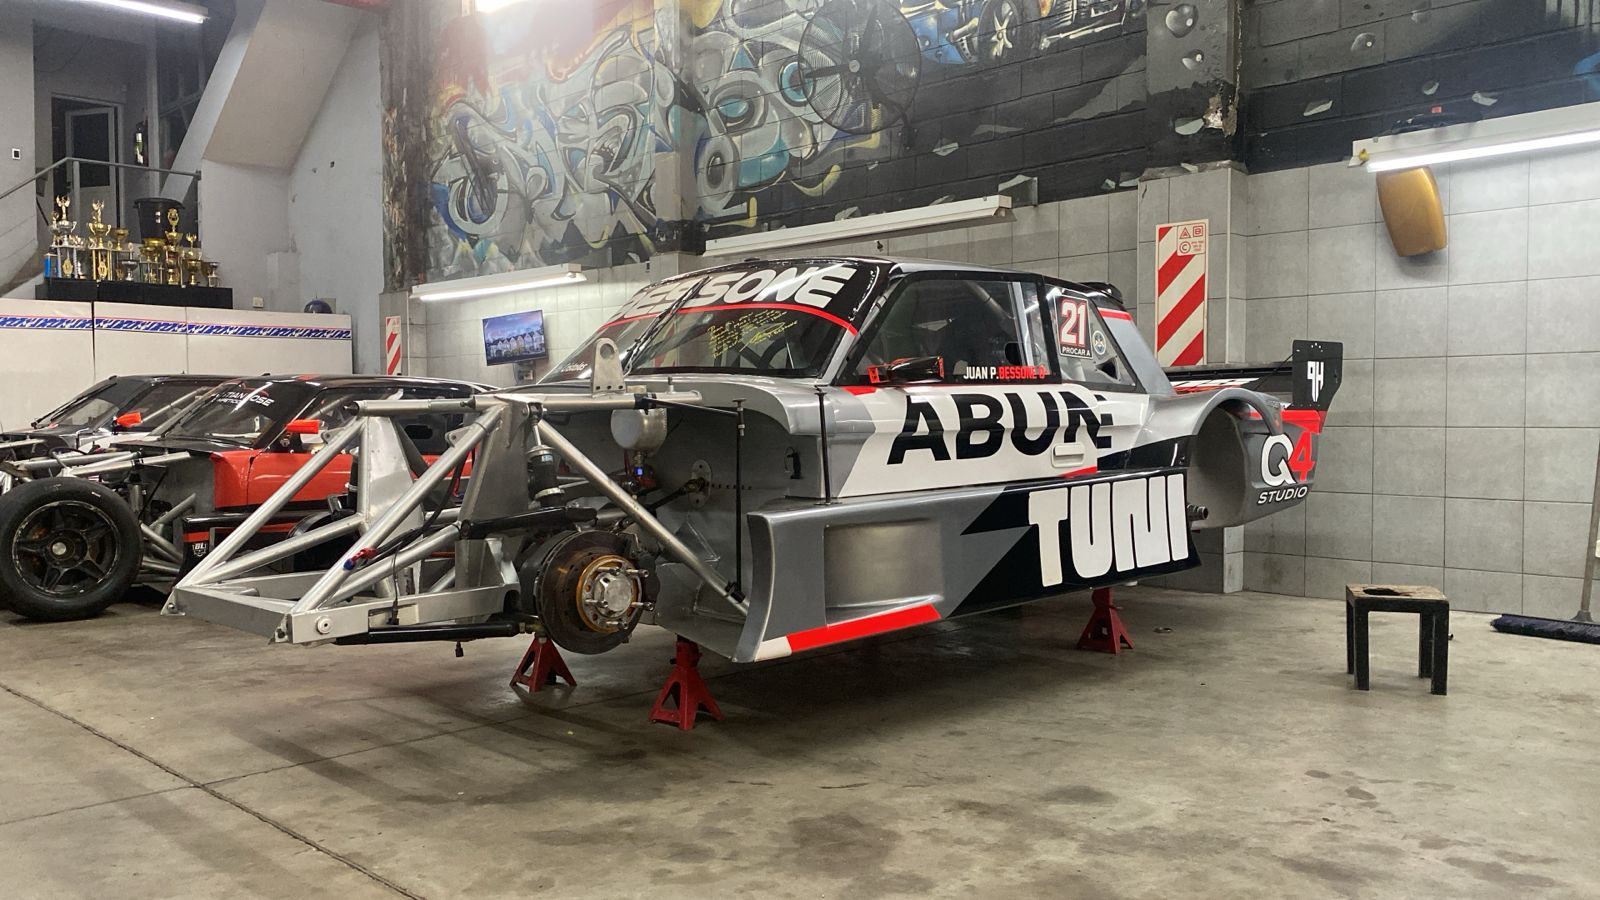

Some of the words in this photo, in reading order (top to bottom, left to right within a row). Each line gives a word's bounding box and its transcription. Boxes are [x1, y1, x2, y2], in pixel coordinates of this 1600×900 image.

[1060, 299, 1087, 347] 21
[1062, 346, 1086, 355] PROCAR
[963, 366, 988, 379] JUAN
[1261, 430, 1316, 487] Q4
[1257, 486, 1308, 505] STUDIO
[1029, 474, 1189, 587] TUNI
